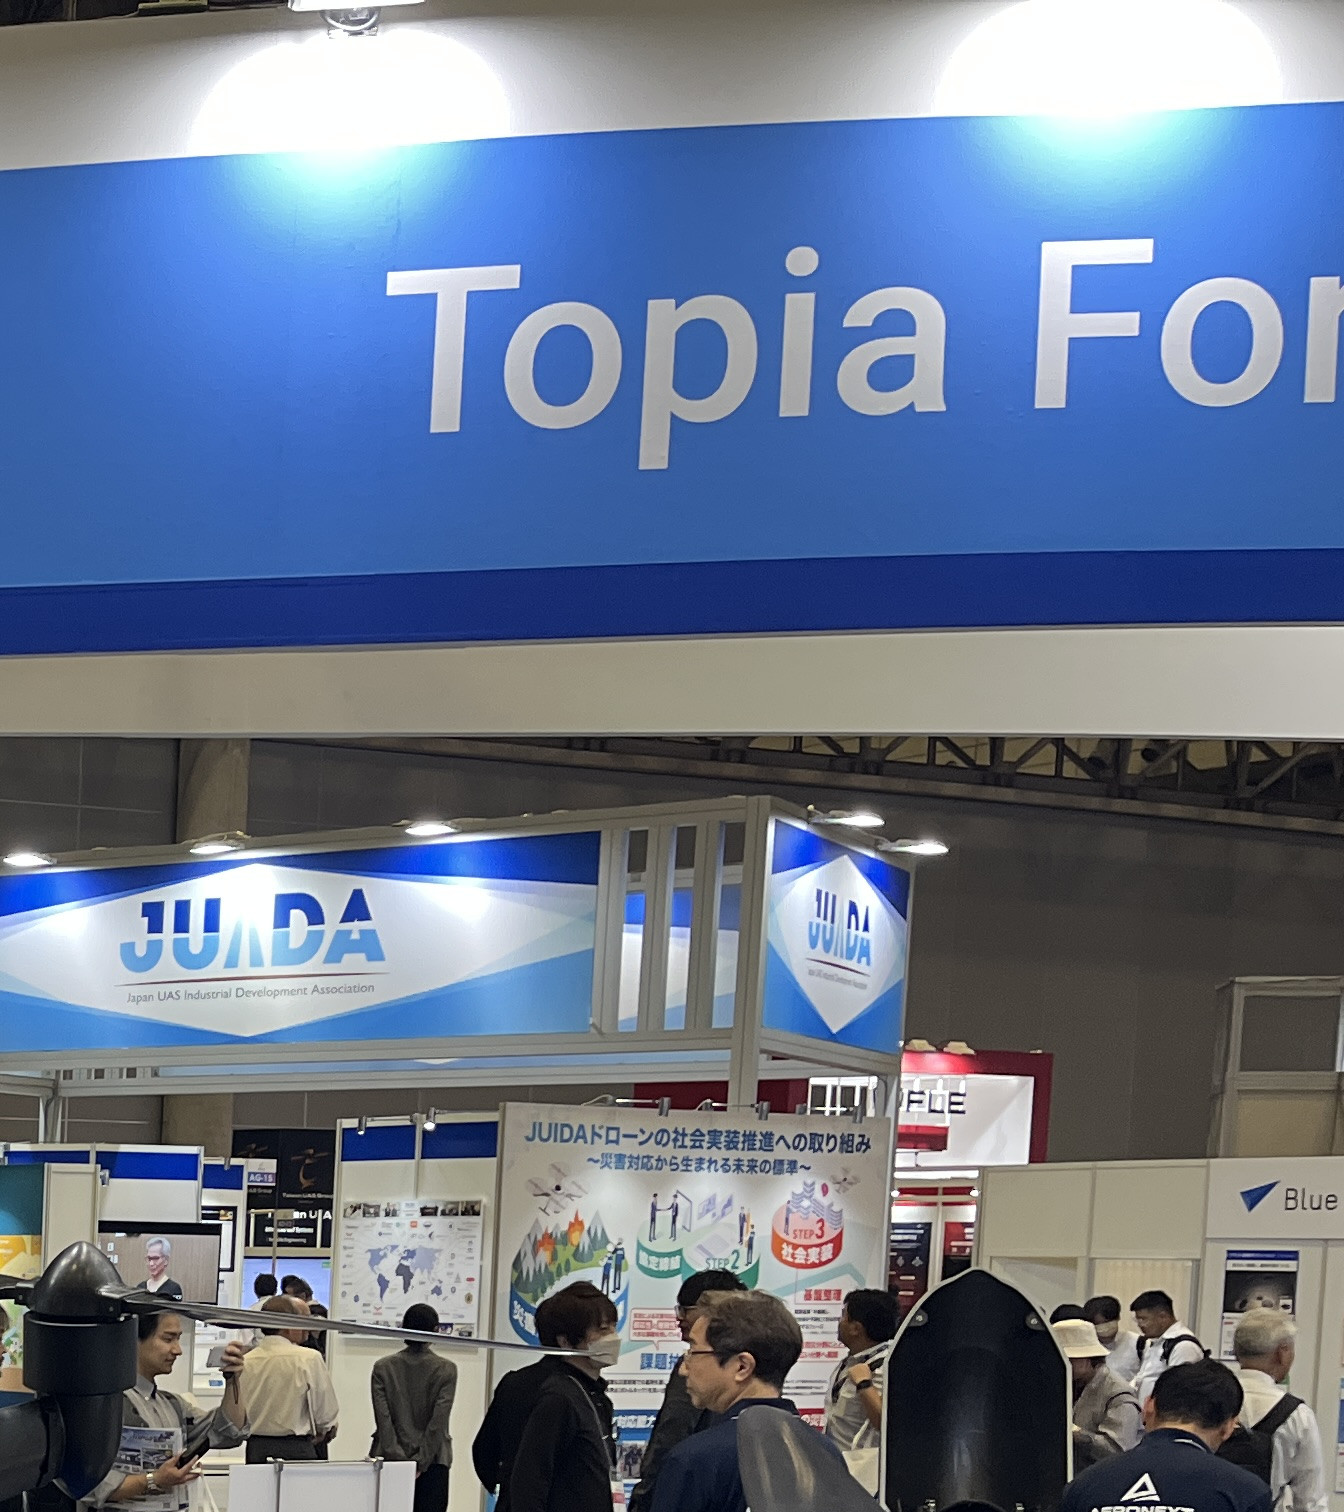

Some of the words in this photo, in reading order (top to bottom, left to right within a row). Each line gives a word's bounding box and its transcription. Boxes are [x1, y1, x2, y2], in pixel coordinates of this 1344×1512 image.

[386, 246, 947, 469] Topia
[126, 991, 154, 1006] Japan
[157, 989, 181, 1002] UAS
[184, 988, 232, 1001] Industrial
[235, 986, 308, 1000] Development
[311, 983, 375, 995] Association
[1284, 1187, 1338, 1211] Blue
[793, 1229, 815, 1241] STEP
